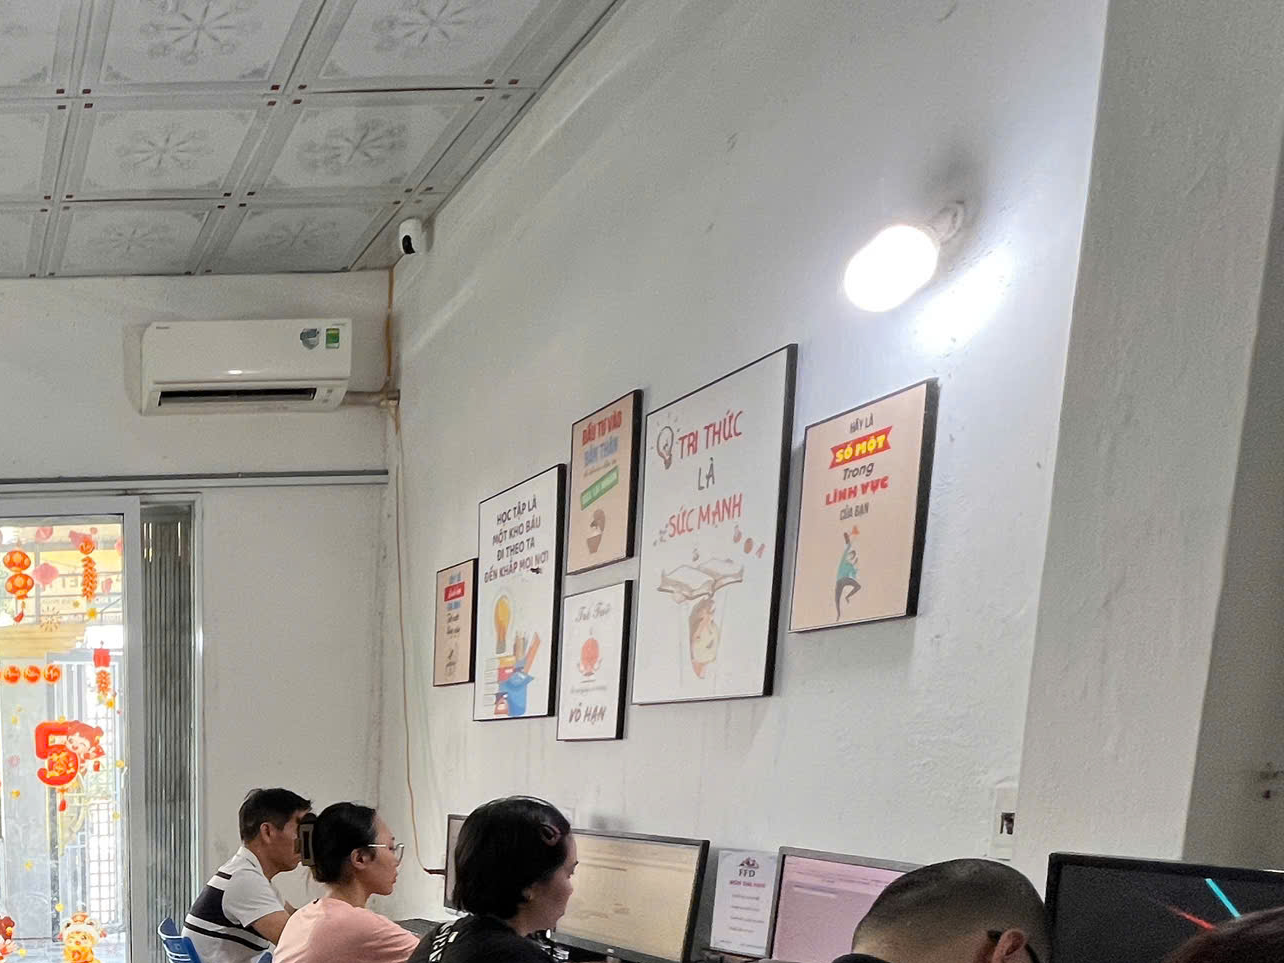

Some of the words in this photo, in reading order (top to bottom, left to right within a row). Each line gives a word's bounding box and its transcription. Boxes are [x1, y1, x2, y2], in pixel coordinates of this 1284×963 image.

[678, 430, 698, 459] TRI
[704, 410, 743, 449] THỨC
[835, 440, 853, 463] SỐ
[855, 434, 886, 456] MỘT
[698, 457, 715, 490] LÀ
[843, 462, 874, 480] Trong
[497, 509, 511, 526] HỌC
[669, 505, 694, 538] SỨC
[697, 492, 743, 530] MẠNH
[509, 523, 524, 539] KHO
[506, 541, 524, 558] THEO
[526, 537, 535, 549] TA
